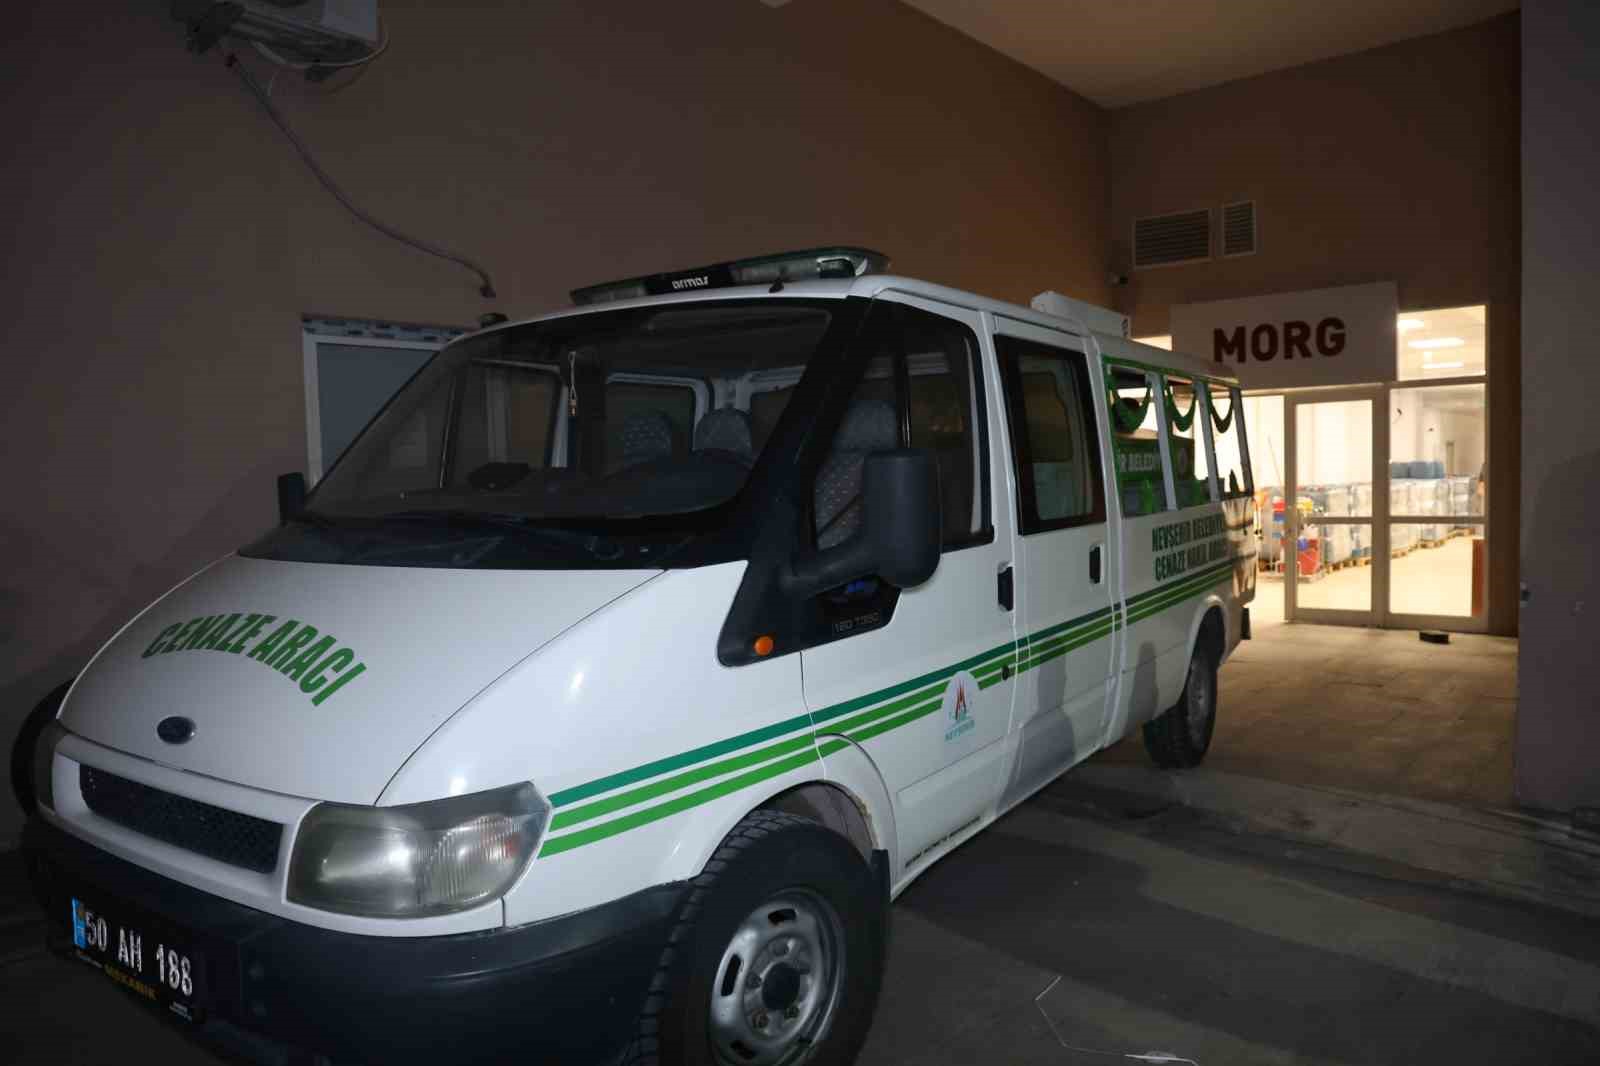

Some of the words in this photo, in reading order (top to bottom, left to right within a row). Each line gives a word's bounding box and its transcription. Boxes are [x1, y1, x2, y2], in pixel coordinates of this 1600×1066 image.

[1213, 316, 1346, 364] MORG
[141, 613, 278, 659] CENAZE
[246, 620, 367, 706] ARACI
[85, 911, 108, 952] 50
[117, 925, 143, 973] AH
[156, 943, 193, 997] 188
